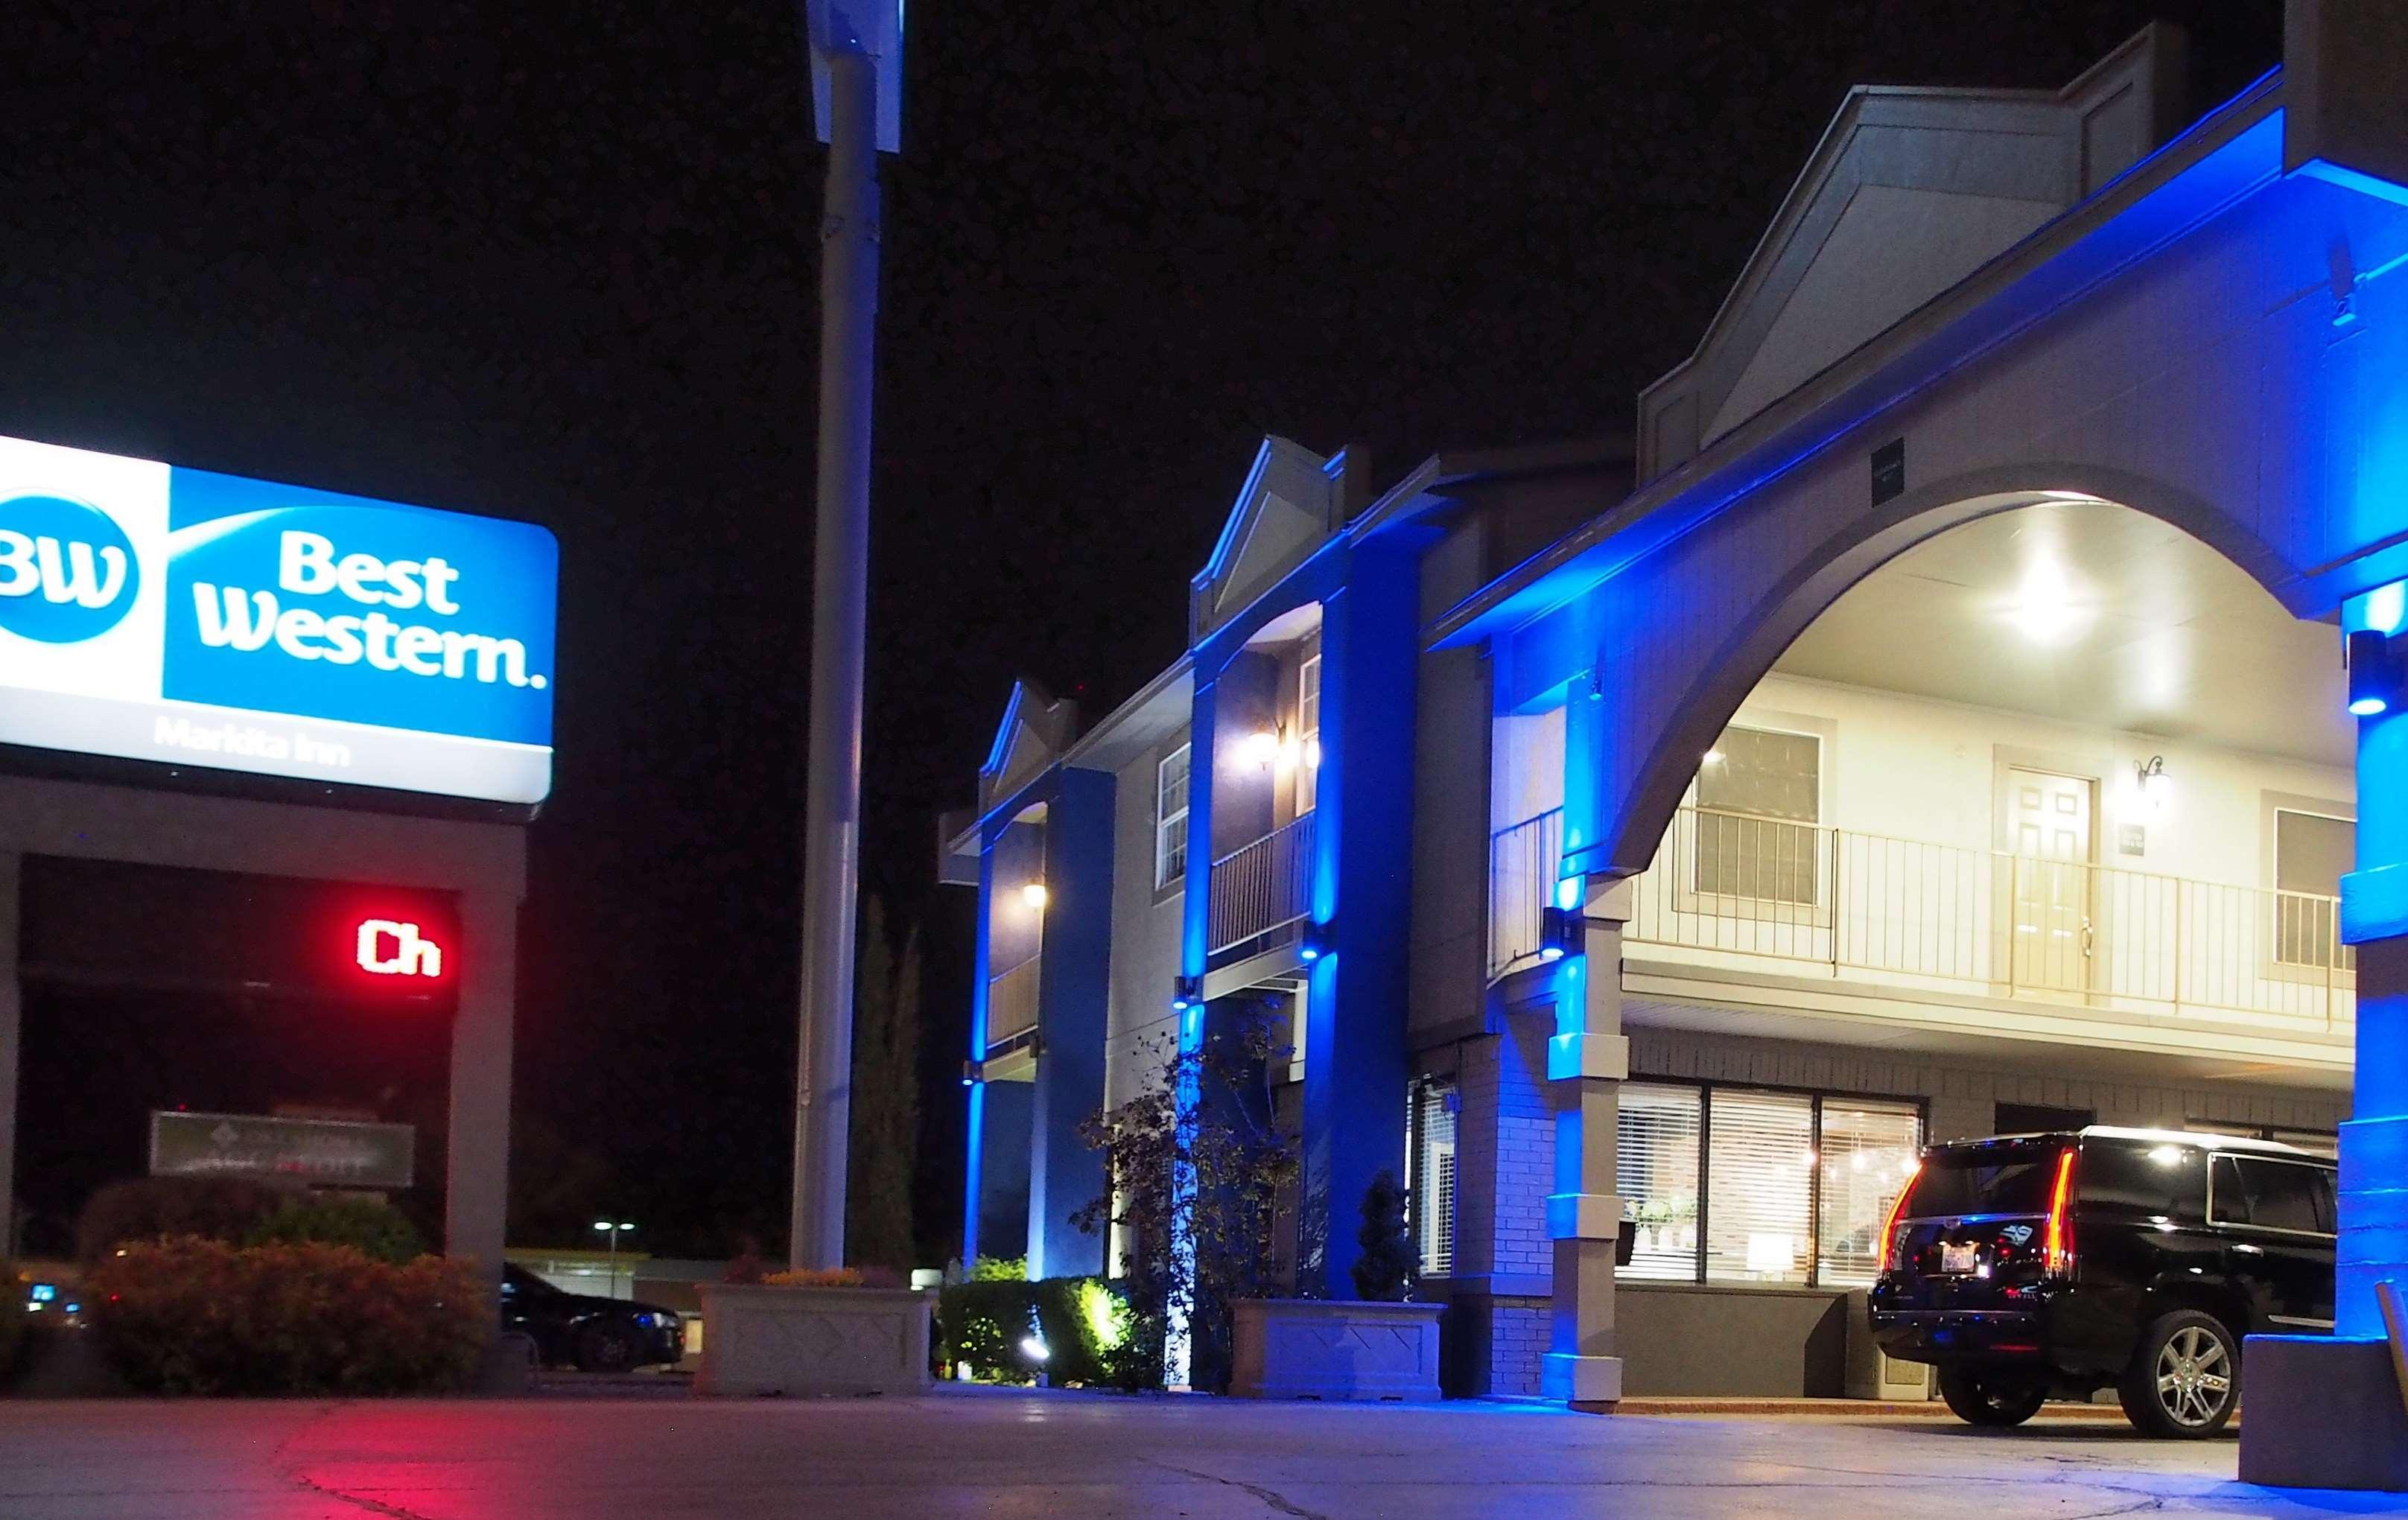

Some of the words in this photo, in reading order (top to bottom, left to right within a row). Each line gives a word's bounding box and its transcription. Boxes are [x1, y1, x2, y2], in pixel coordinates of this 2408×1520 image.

[279, 530, 460, 615] Best
[294, 731, 351, 768] Inn
[356, 918, 442, 977] Ch
